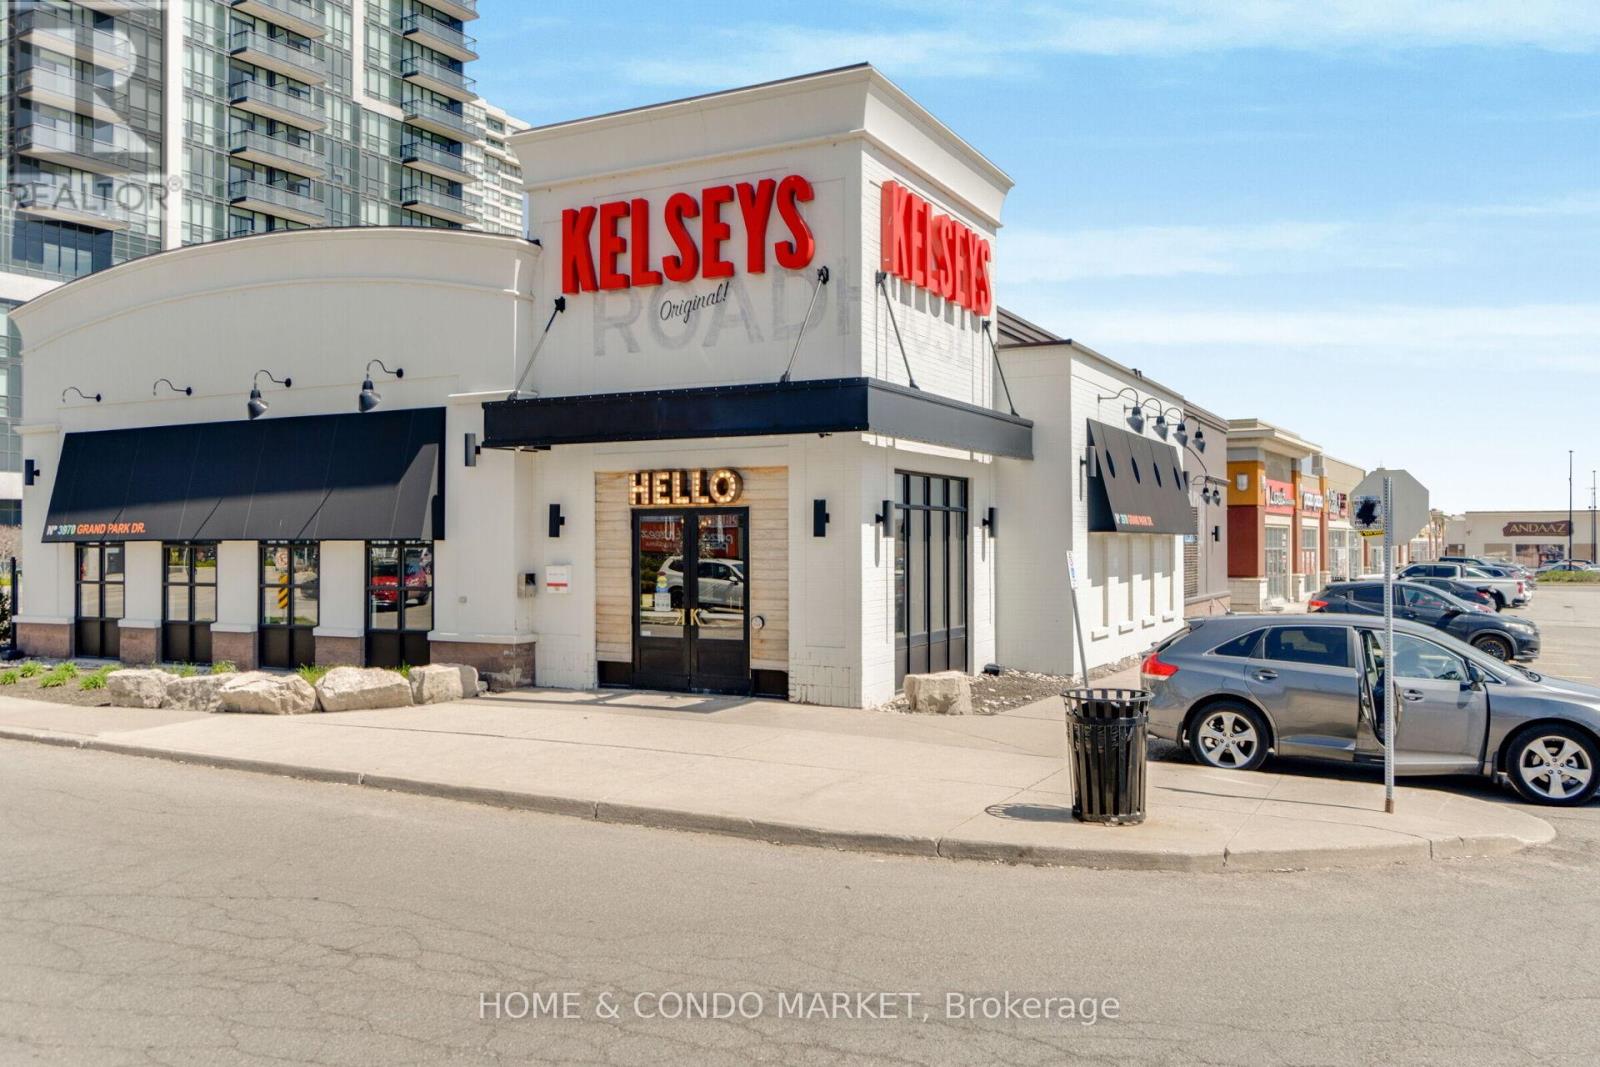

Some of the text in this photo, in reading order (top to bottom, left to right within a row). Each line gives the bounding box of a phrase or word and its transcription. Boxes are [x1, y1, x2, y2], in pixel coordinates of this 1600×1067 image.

[562, 175, 814, 294] KELSEYS
[881, 180, 992, 316] KELSEYS
[660, 281, 729, 324] Original!
[628, 468, 743, 505] HELLO
[77, 523, 106, 535] GRAND
[107, 523, 131, 534] PARK
[131, 522, 146, 534] DR.
[1509, 523, 1567, 533] ANDAAZ
